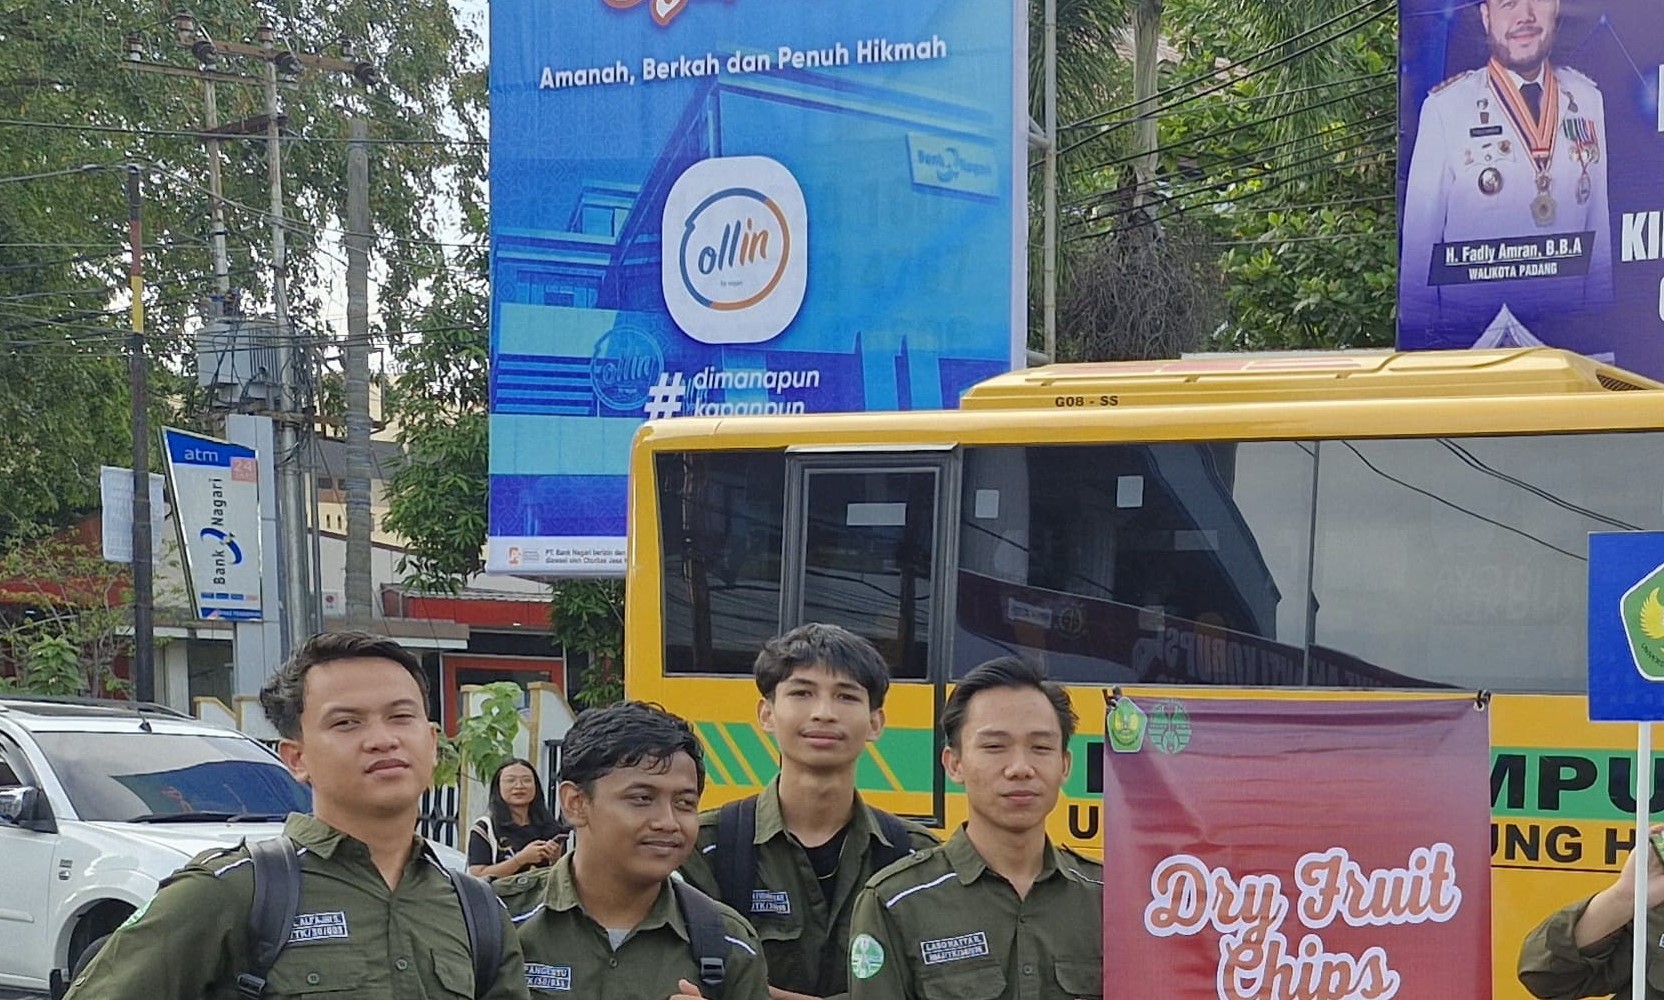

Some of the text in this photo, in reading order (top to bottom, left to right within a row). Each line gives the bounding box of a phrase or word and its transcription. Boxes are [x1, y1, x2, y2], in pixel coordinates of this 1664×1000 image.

[539, 36, 947, 90] Amanah, Berkah dan Penuh Hikmah
[1446, 246, 1459, 264] H.
[1461, 242, 1496, 264] Fadly
[1546, 238, 1582, 257] B.B.A
[1468, 262, 1558, 280] WALIKOTA PADANG
[694, 367, 820, 391] dimanapun
[1055, 395, 1118, 407] G08 SS
[184, 449, 219, 462] atm
[209, 478, 227, 585] Bank Nagari
[1145, 843, 1461, 942] Dry Fruit
